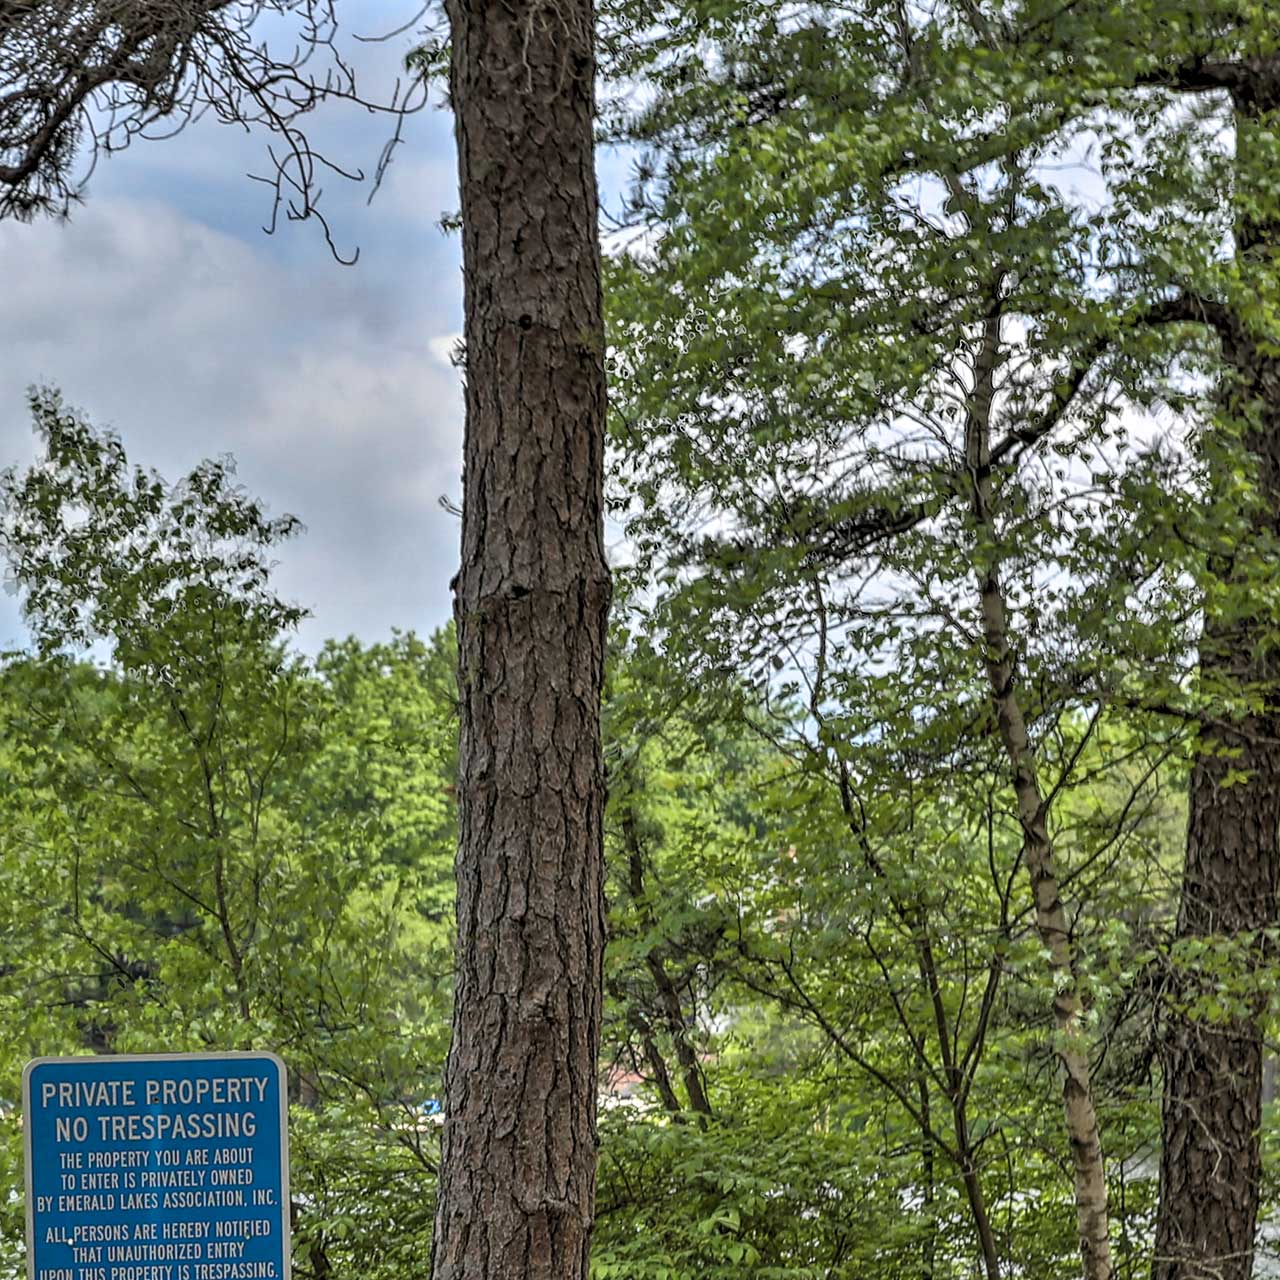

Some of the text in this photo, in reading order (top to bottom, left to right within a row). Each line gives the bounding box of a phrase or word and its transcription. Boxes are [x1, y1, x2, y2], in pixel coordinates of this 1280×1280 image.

[42, 1077, 268, 1107] PRIVATE PROPERTY
[56, 1111, 255, 1142] NO TRESPASSING
[59, 1147, 252, 1168] THE PROPERTY YOU ARE ABOUT
[60, 1168, 252, 1190] TO ENTER IS PRIVATELY OWNED
[72, 1241, 244, 1263] THAT UNAUTHORIZED ENTRY
[178, 1264, 189, 1280] IS
[194, 1262, 278, 1280] TRESPASSING.
